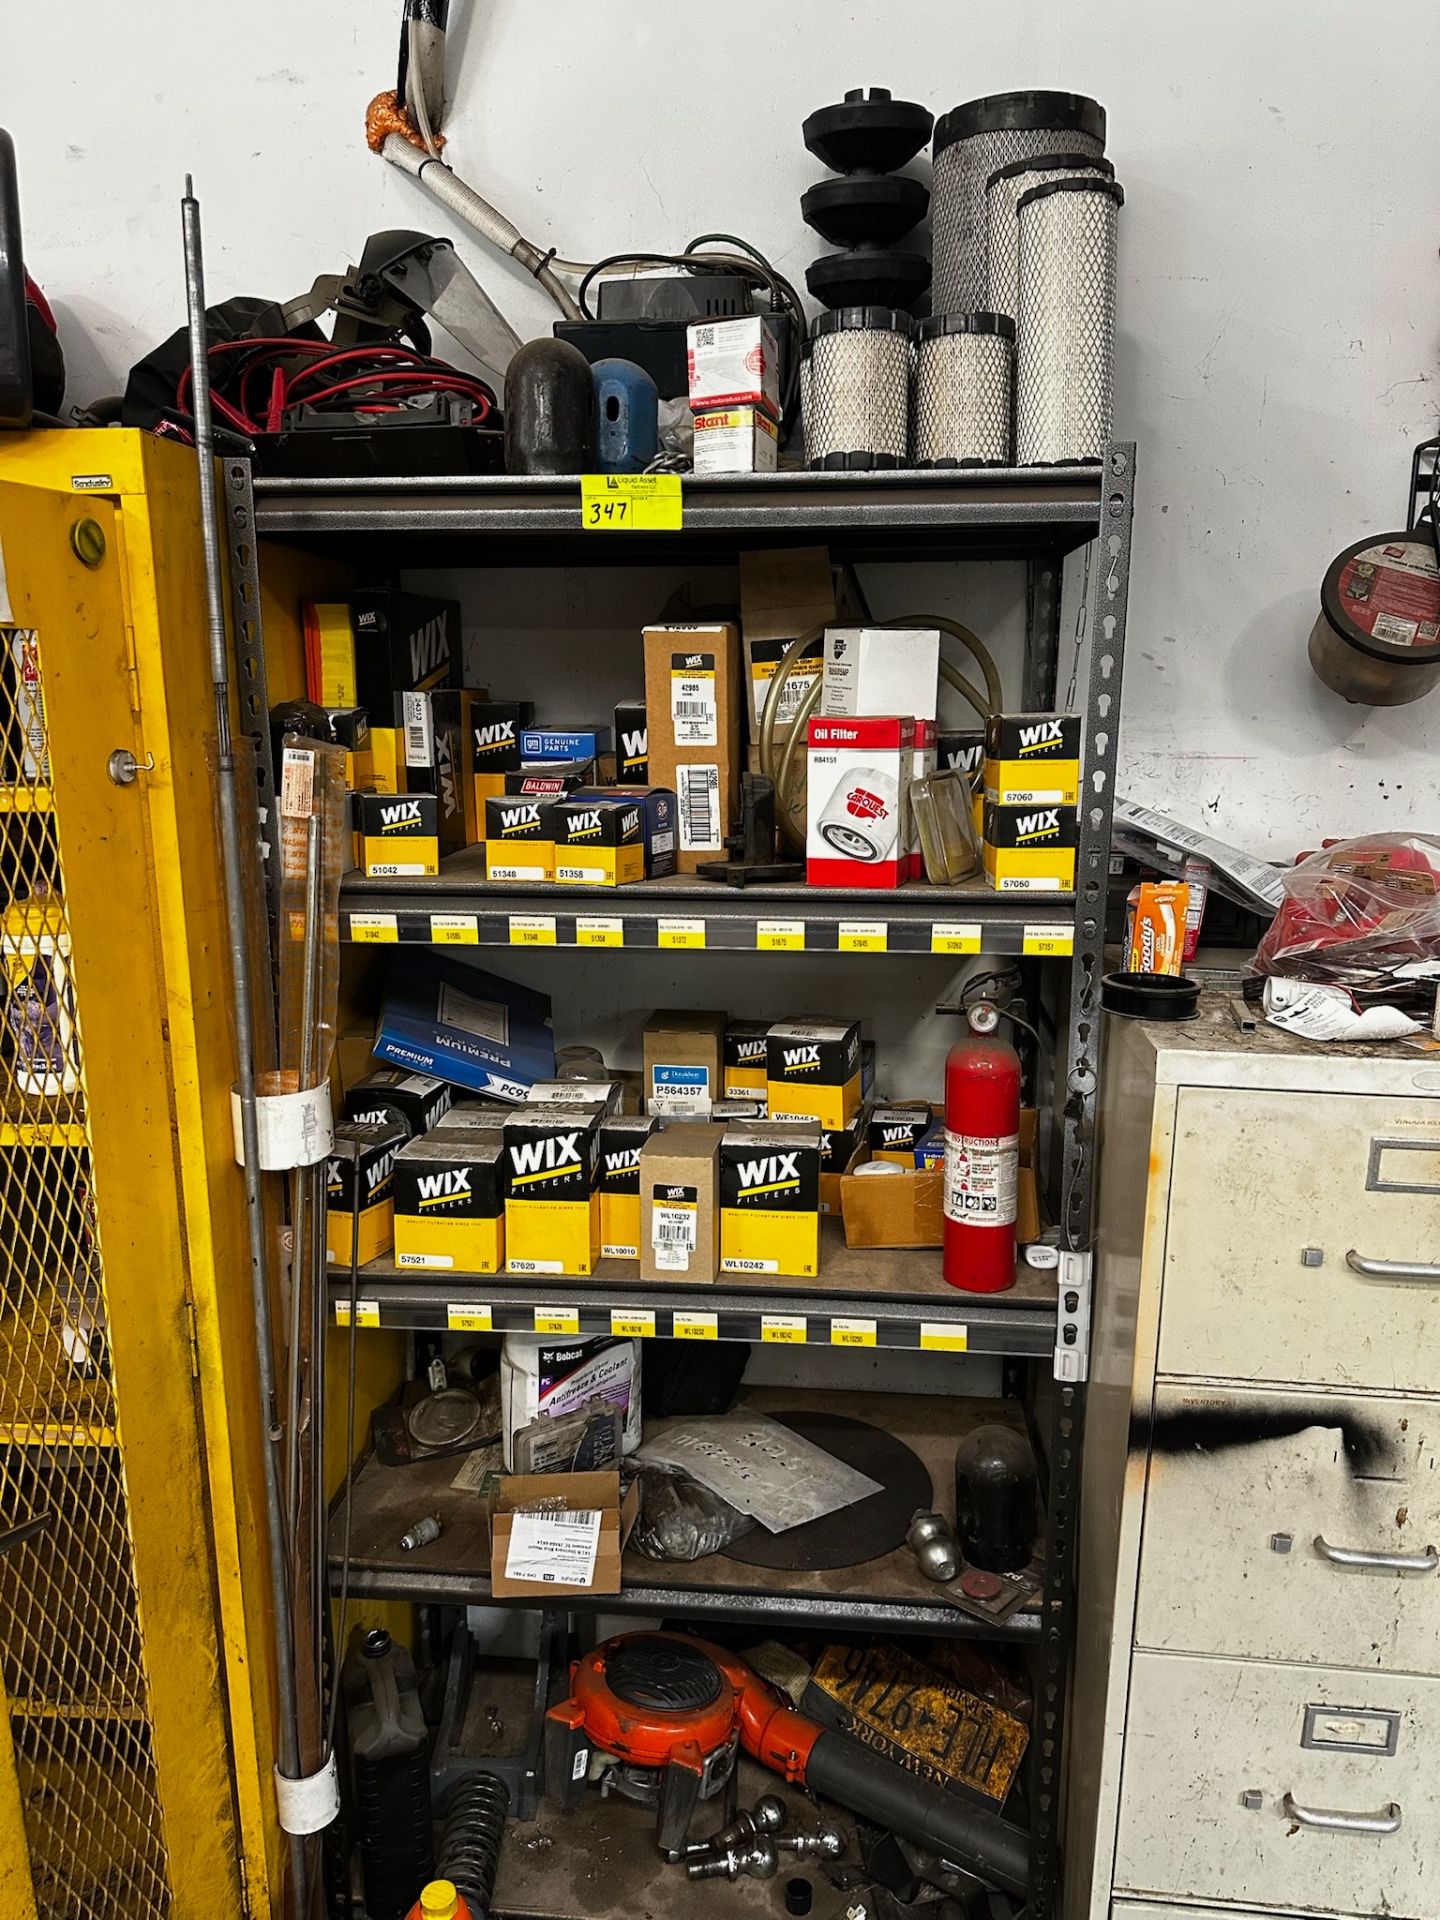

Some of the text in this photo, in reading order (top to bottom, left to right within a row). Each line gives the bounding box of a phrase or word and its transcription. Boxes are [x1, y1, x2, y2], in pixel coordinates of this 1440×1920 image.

[694, 414, 728, 430] Stant
[640, 476, 657, 484] Asset
[590, 502, 627, 524] 347
[358, 612, 376, 623] WIX
[410, 610, 450, 682] WIX
[685, 655, 702, 666] WIX
[681, 684, 699, 692] 42985
[784, 681, 810, 690] 1675
[414, 698, 422, 721] 24313
[474, 720, 516, 746] WIX
[814, 728, 858, 740] Oil Filter
[1019, 718, 1064, 748] WIX
[526, 738, 538, 750] gm
[544, 738, 580, 746] GENUINE
[948, 746, 982, 771] WI
[1019, 744, 1064, 758] FILTERS
[525, 780, 560, 790] BALDWIN
[380, 800, 422, 824] WIX
[500, 803, 541, 828] WIX
[567, 809, 602, 832] WIX
[622, 808, 639, 832] WIX
[1016, 808, 1060, 835] WIX
[1016, 832, 1060, 847] FILTERS
[492, 870, 517, 878] 51348
[559, 870, 584, 878] 51358
[1003, 880, 1030, 888] 57060
[386, 1044, 434, 1065] PREMIUM
[436, 1035, 511, 1068] PREMIUM
[737, 1040, 767, 1057] WIX
[783, 1045, 820, 1066] WIX
[656, 1086, 702, 1096] P564357
[353, 1109, 388, 1124] WIX
[425, 1086, 452, 1133] WIX
[883, 1124, 914, 1142] WIX
[510, 1132, 582, 1175] WIX
[605, 1148, 641, 1170] WIX
[737, 1152, 800, 1188] WIX
[417, 1167, 472, 1199] WIX
[511, 1172, 582, 1194] FILTERS
[667, 1187, 684, 1196] WIX
[737, 1187, 801, 1205] FILTERS
[419, 1198, 472, 1213] FILTERS
[661, 1212, 690, 1220] WL10232
[604, 1247, 635, 1255] WL10010
[401, 1256, 425, 1264] 57521
[510, 1262, 535, 1270] 57620
[725, 1260, 764, 1270] WL10242
[556, 1350, 582, 1361] Bobcat
[550, 1358, 627, 1406] Antifreeze & Coolant
[835, 1648, 1006, 1785] HLE 9746
[848, 1716, 950, 1789] NEW YORK
